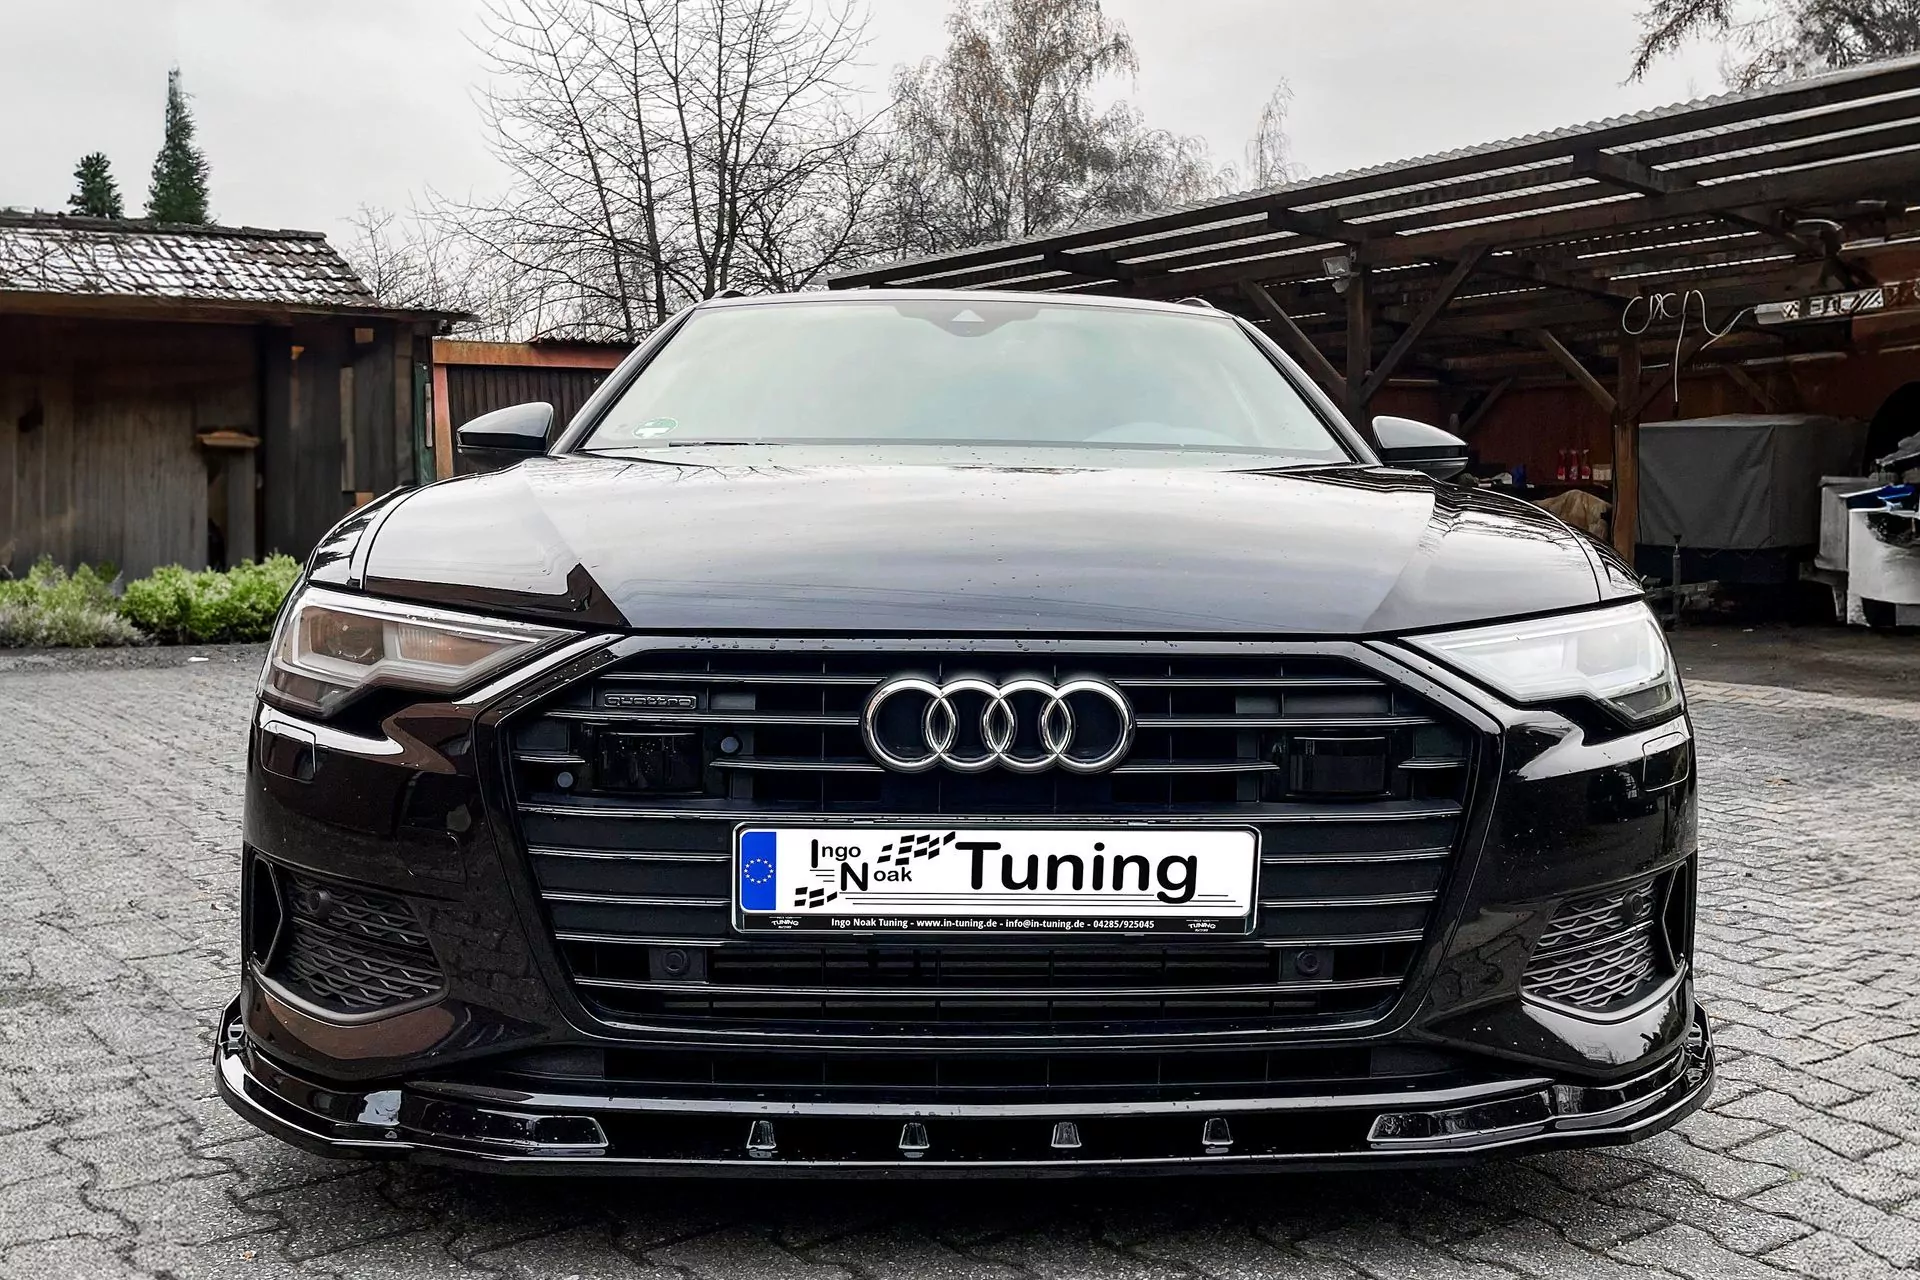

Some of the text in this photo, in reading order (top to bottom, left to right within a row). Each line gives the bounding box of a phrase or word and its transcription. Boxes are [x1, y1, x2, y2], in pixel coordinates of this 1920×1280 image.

[607, 696, 692, 706] quattro
[811, 838, 862, 869] Ingo
[840, 861, 913, 892] Noak
[954, 841, 1198, 904] Tuning
[831, 917, 851, 929] Ingo
[853, 917, 877, 927] Noak
[878, 918, 908, 929] Tuning
[916, 918, 998, 929] www.in-tuning.de
[1005, 918, 1085, 930] info@in-tuning.de
[1093, 919, 1155, 929] 04285/925045
